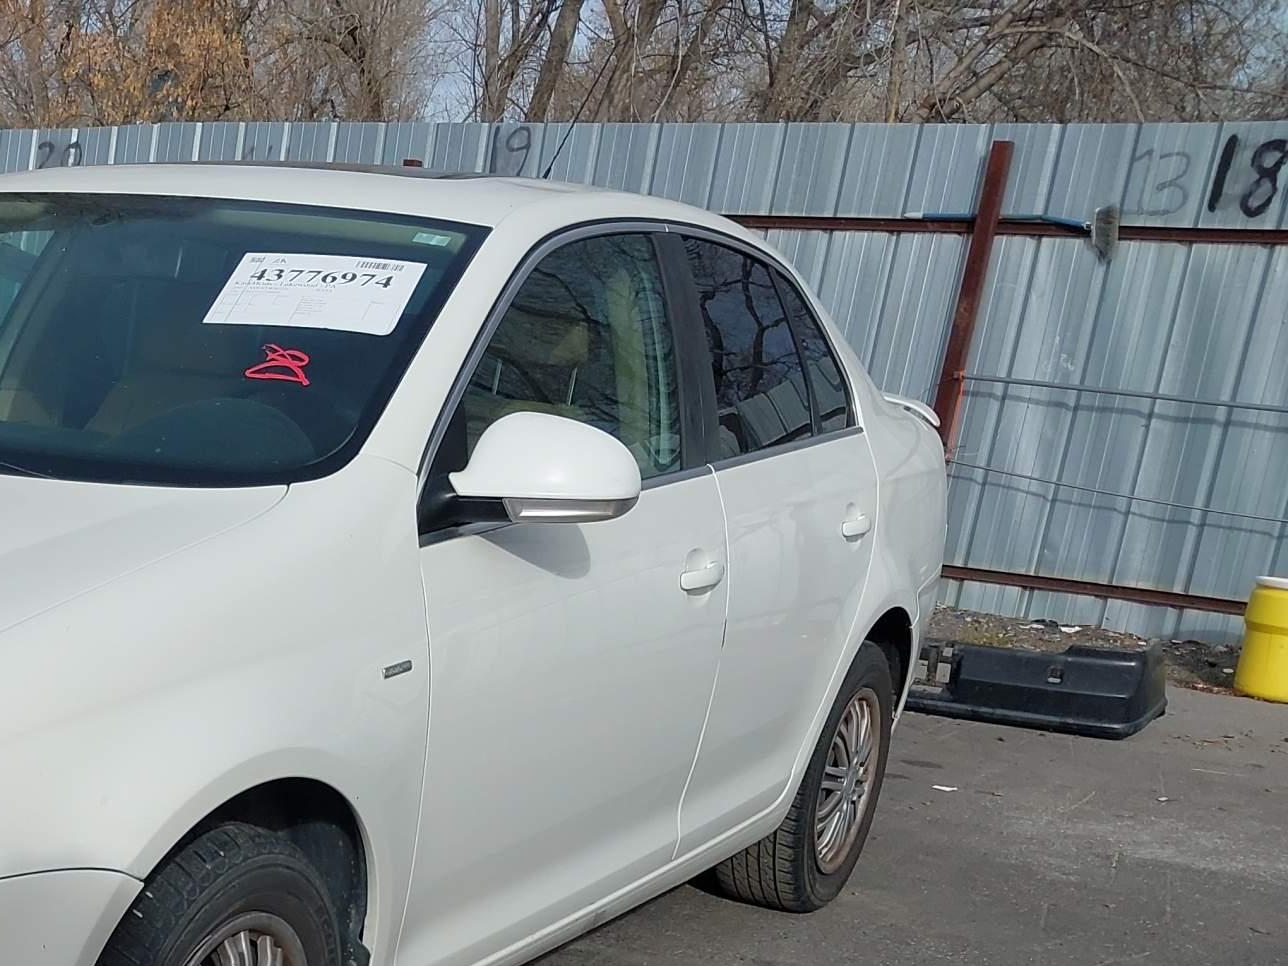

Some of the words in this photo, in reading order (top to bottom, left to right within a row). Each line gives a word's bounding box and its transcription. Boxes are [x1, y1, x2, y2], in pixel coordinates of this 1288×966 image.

[489, 125, 532, 177] 19
[1207, 133, 1288, 218] 18
[1123, 147, 1191, 216] 13
[249, 268, 395, 289] 43776974
